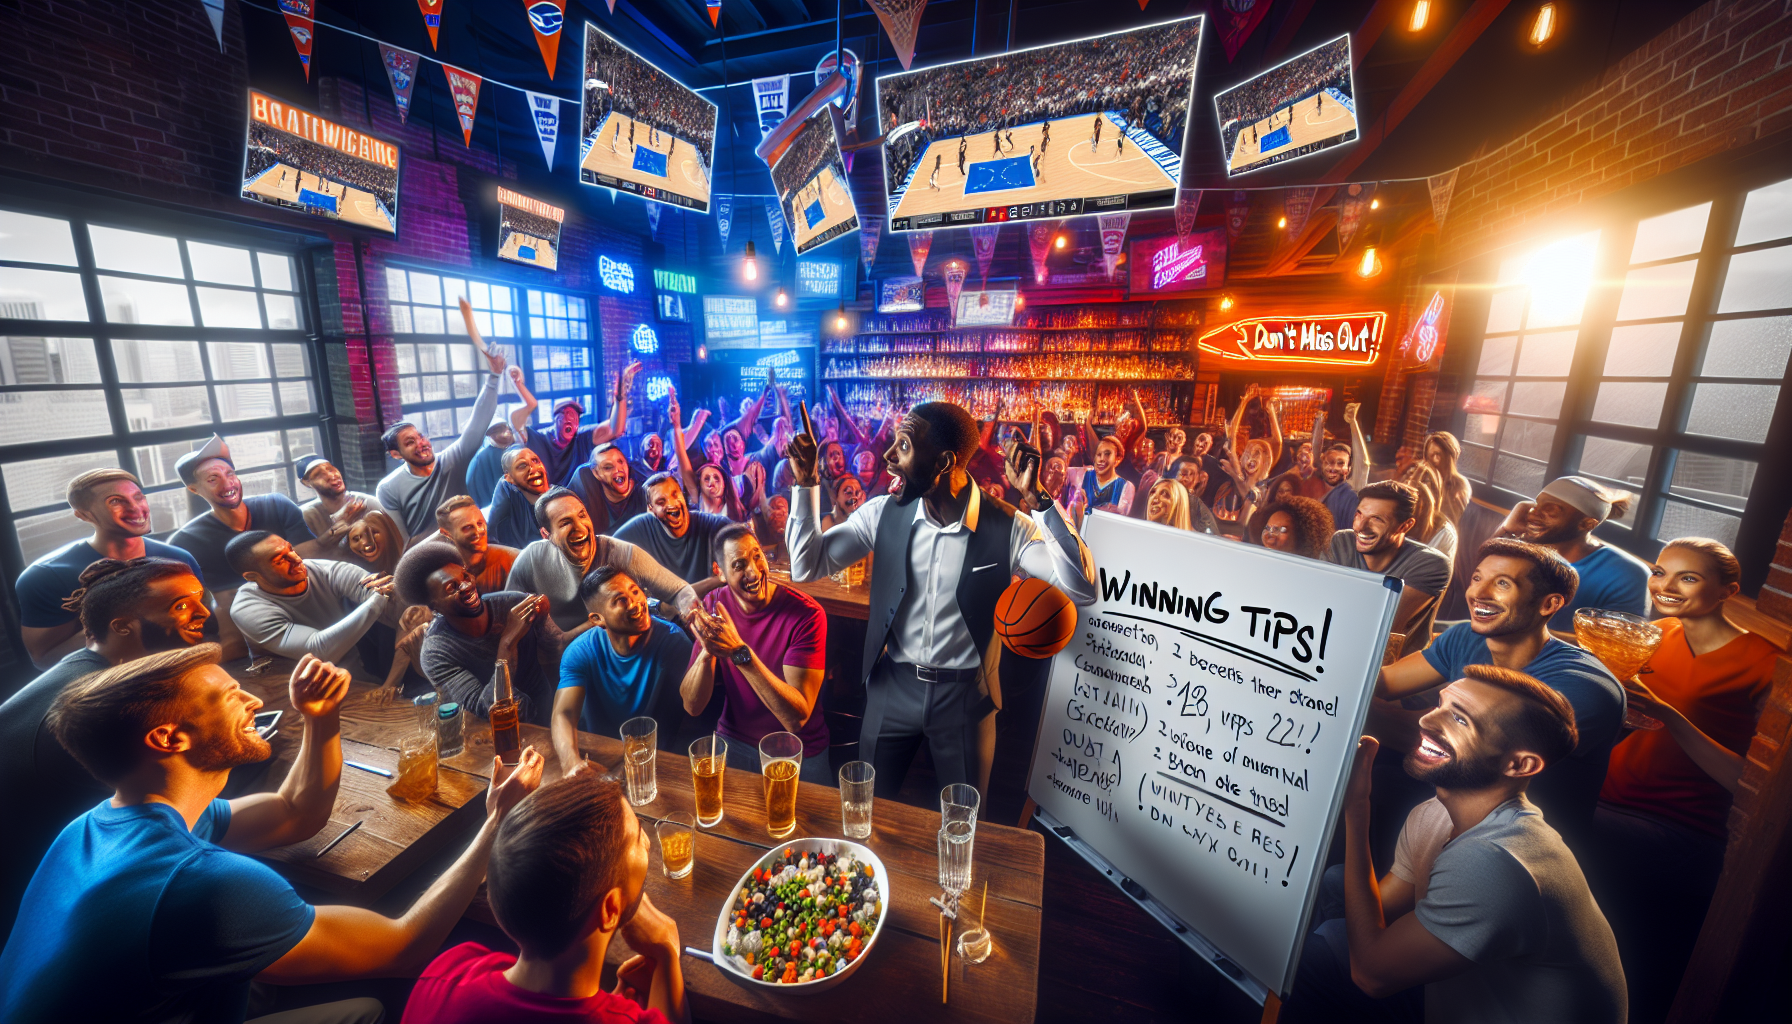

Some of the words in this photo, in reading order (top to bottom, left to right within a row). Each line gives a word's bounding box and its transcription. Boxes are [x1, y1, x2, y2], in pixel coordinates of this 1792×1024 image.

[1253, 322, 1297, 351] Don't
[1337, 315, 1380, 352] Out!
[1100, 567, 1230, 625] WINNING
[1241, 608, 1333, 674] TIPS!
